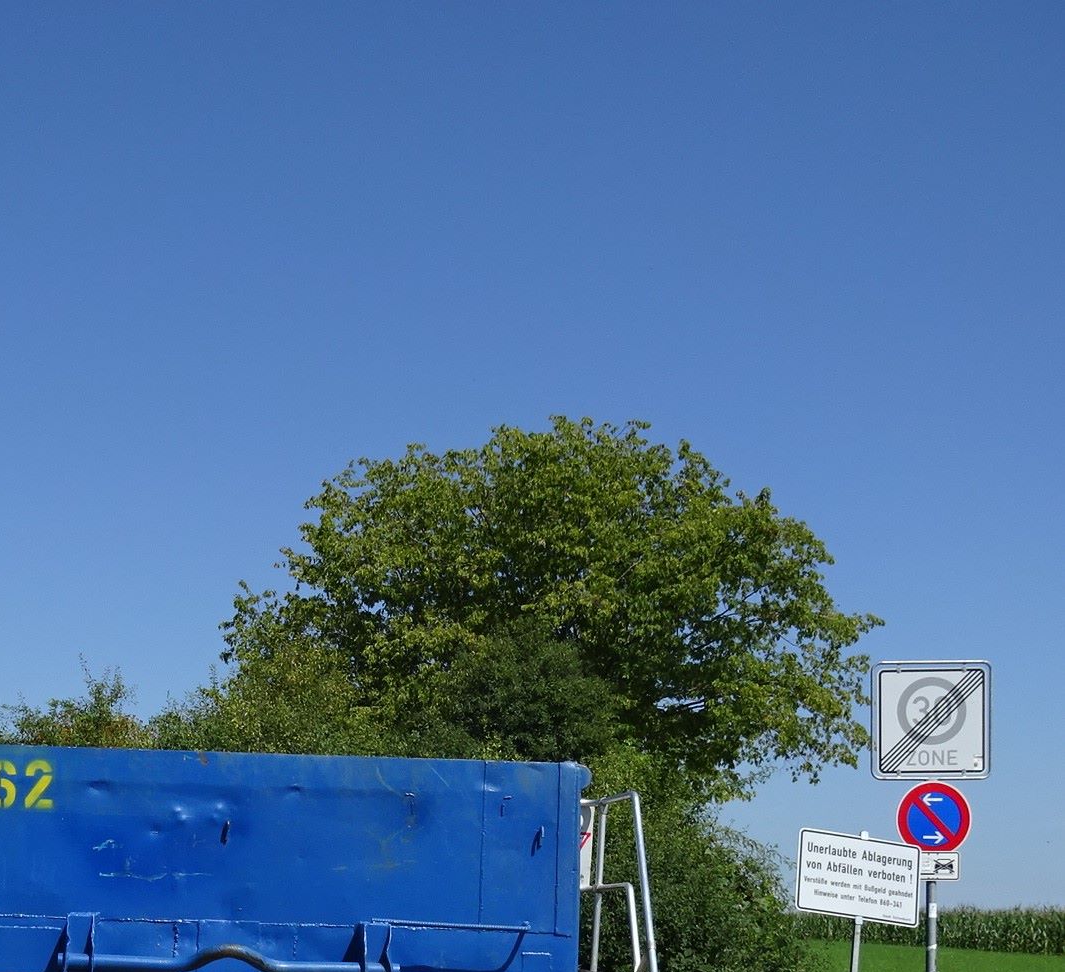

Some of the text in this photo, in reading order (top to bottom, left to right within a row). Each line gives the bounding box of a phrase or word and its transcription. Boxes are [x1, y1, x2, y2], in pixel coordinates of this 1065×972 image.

[906, 750, 958, 766] ZONE
[807, 841, 858, 859] Unerlaubte
[861, 850, 913, 870] Ablagerung
[806, 860, 822, 870] von
[826, 861, 863, 876] Abfällen
[868, 869, 906, 883] verboten
[804, 876, 828, 885] Verstöße
[830, 879, 851, 888] werden
[864, 884, 886, 894] Bußgeld
[888, 888, 913, 898] geahndet
[813, 889, 838, 899] Hinweise
[840, 892, 855, 901] unter
[858, 895, 878, 904] Telefon
